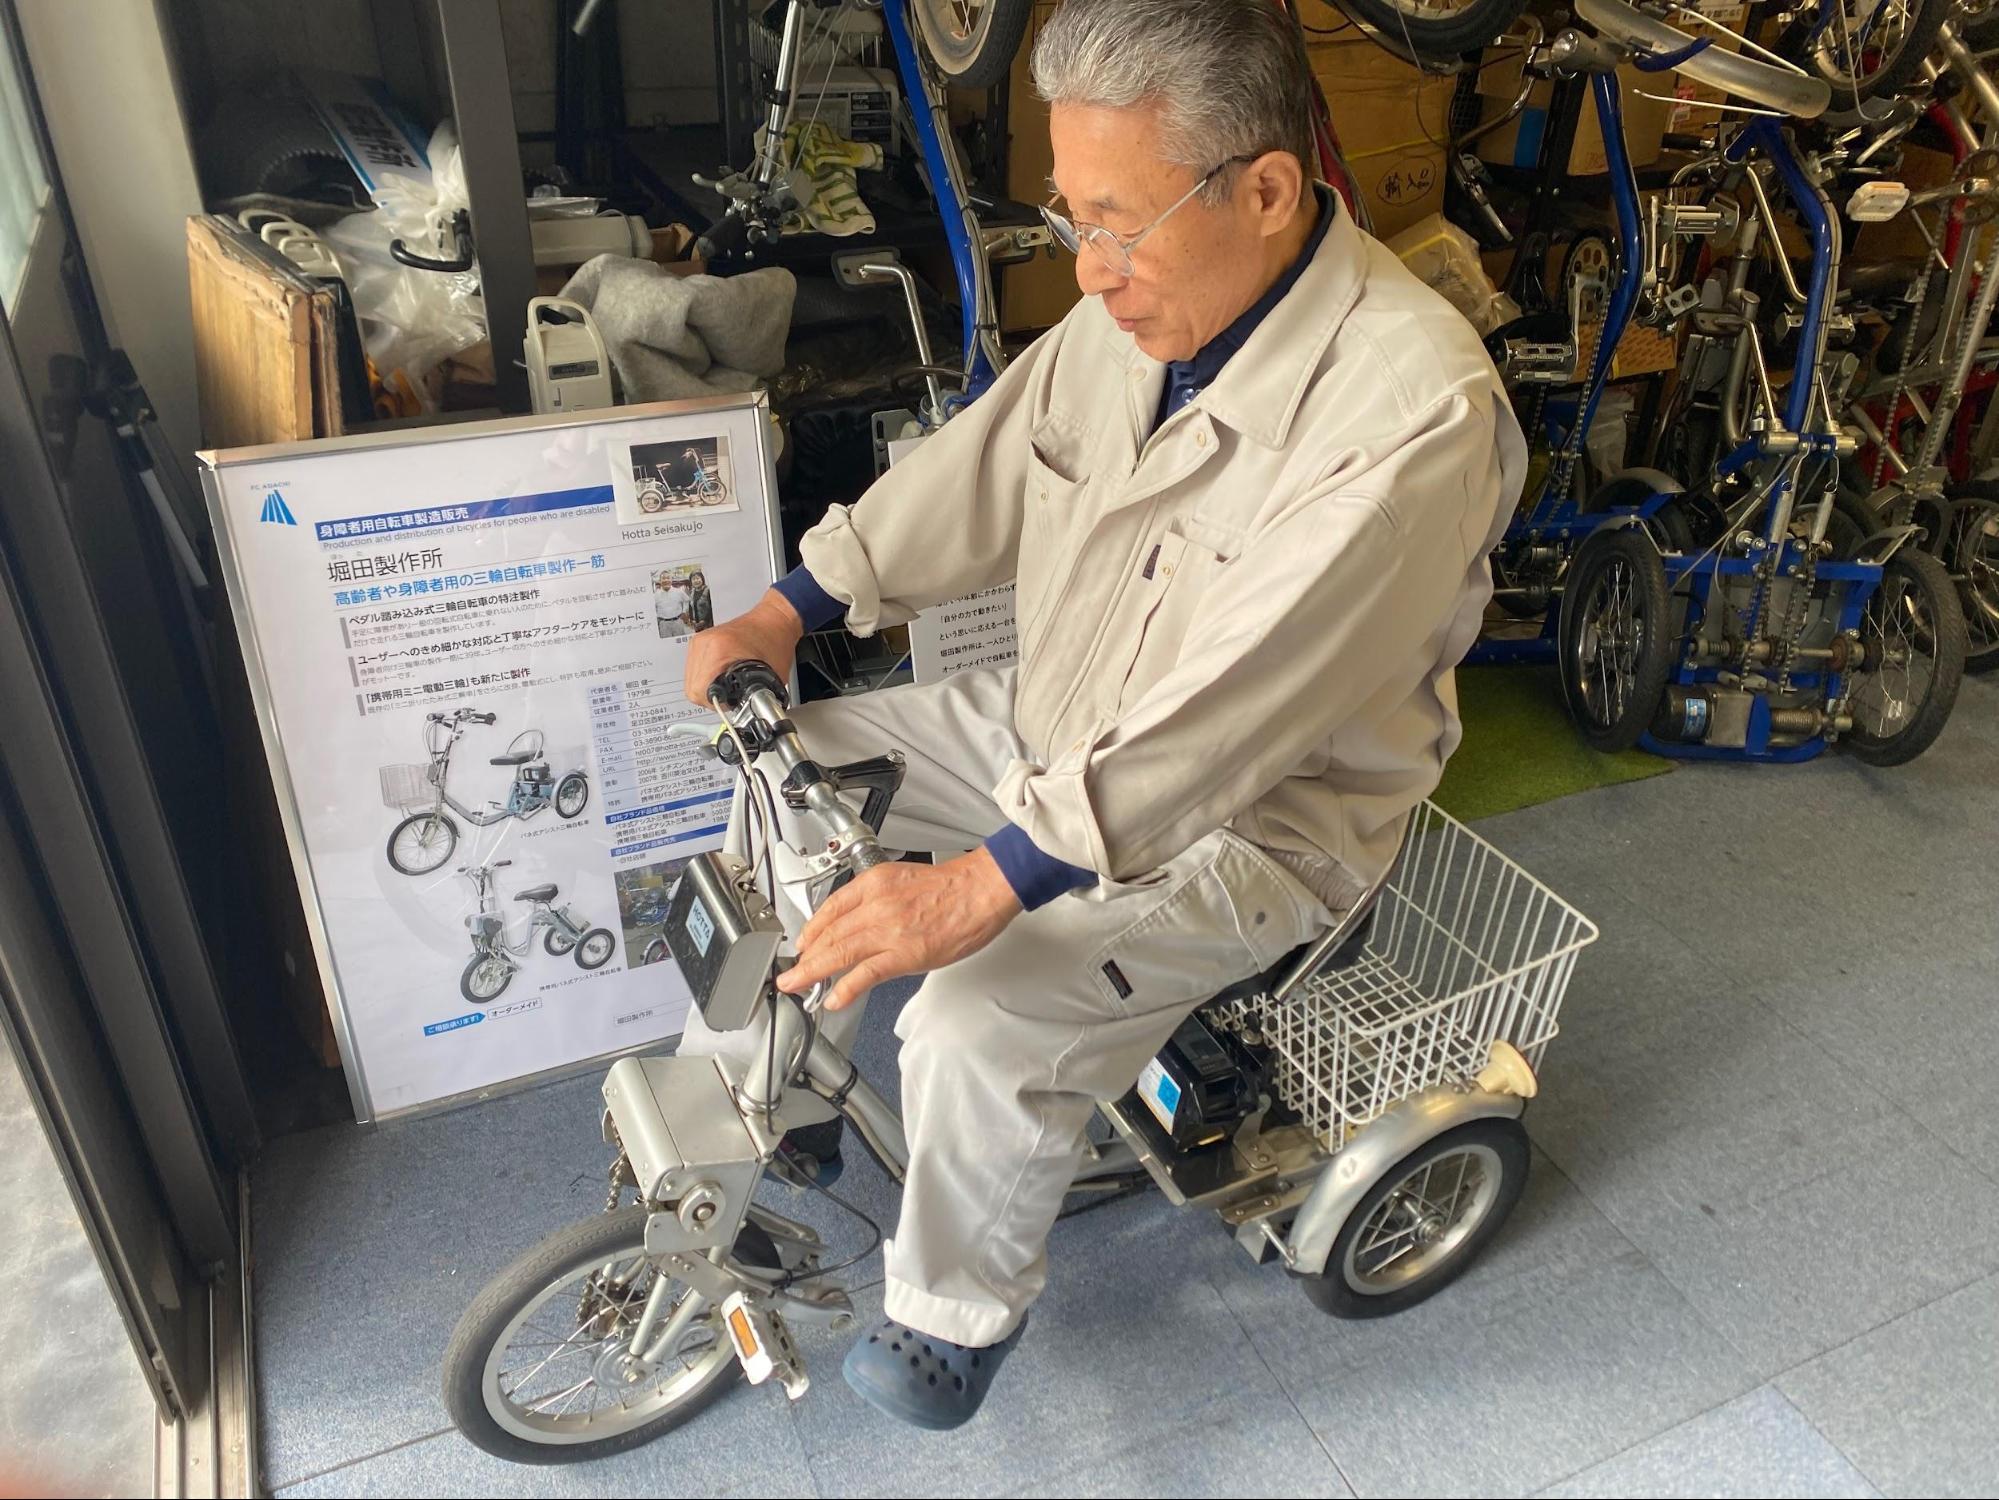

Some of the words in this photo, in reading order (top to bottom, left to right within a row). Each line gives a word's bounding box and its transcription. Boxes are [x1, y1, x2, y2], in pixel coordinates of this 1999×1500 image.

[319, 507, 469, 538] 身障者用自転車製造販売
[323, 537, 372, 550] Production
[374, 533, 392, 543] and
[394, 526, 444, 541] distribution
[446, 524, 455, 534] of
[457, 519, 492, 533] bicycles
[493, 517, 505, 527] for
[508, 511, 537, 526] people
[539, 510, 558, 522] who
[560, 509, 574, 519] are
[575, 505, 610, 517] disabled
[621, 529, 651, 541] Hotta
[327, 547, 443, 583] 堀田製作所
[334, 554, 605, 606] 高齢者や身障者用の三輪自転車製作一筋
[349, 589, 541, 625] ペダル踏み込み式三輪自転車の特注製作
[358, 611, 645, 665] ユーザーへのきめ細かな対応と丁寧なアフターケアをモットーに
[940, 633, 1018, 657] 堀田製作所は、一人ひとり
[365, 667, 531, 703] 「携帯用ミニ電動三輪」も新たに製作
[693, 904, 710, 939] HOTTA
[490, 1000, 539, 1017] オーダーメイド
